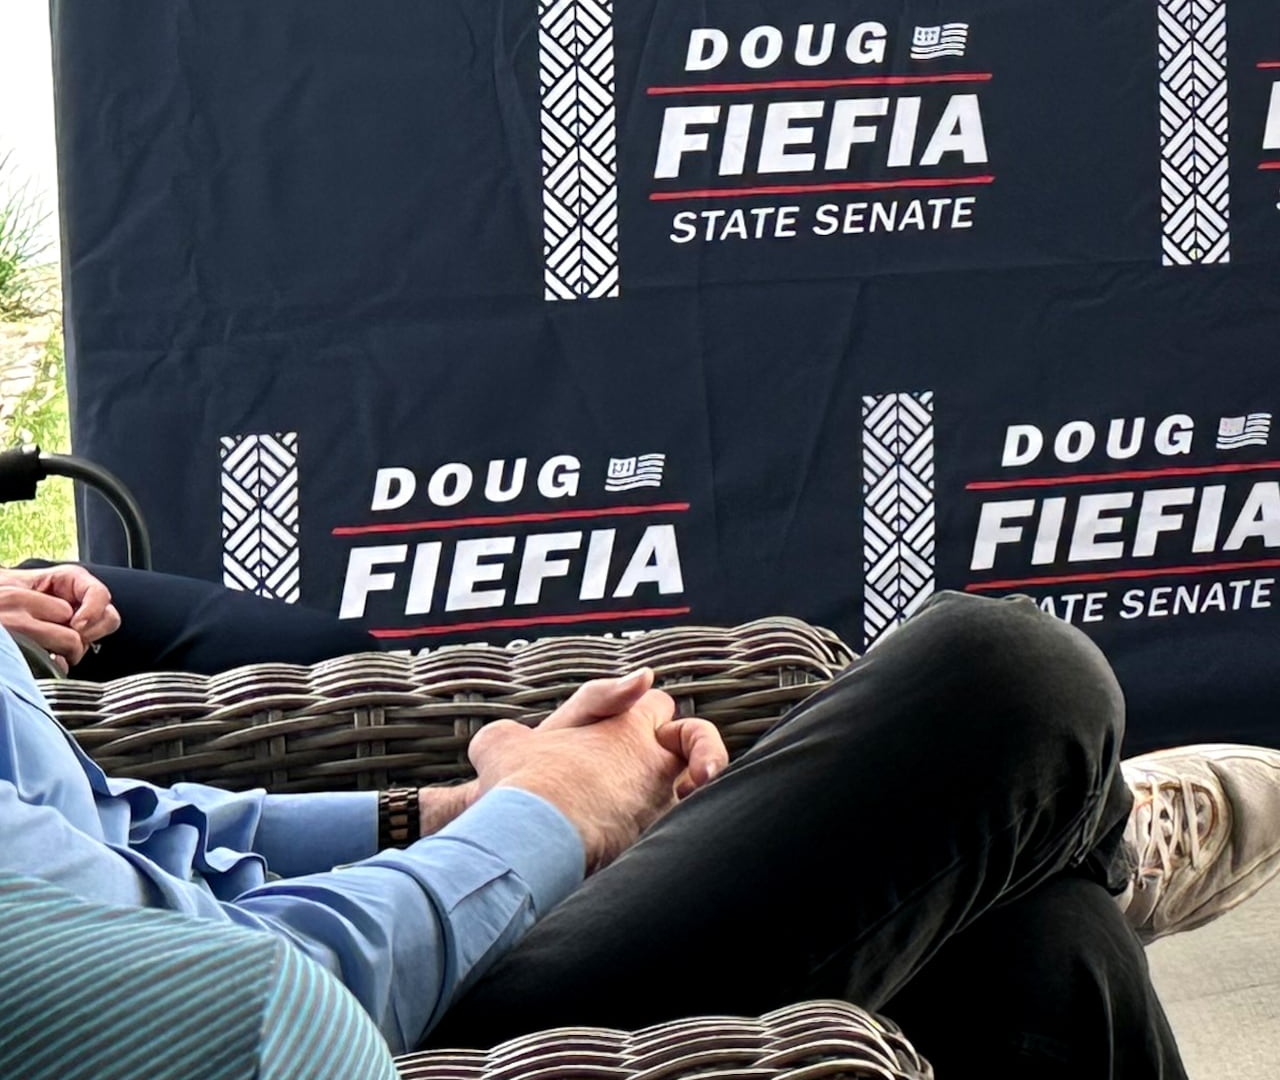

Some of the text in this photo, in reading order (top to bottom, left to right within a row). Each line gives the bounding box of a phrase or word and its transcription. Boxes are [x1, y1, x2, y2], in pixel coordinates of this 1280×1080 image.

[684, 21, 888, 71] DOUG
[653, 93, 988, 179] FIEFIA
[669, 196, 976, 244] STATE SENATE
[1001, 414, 1194, 467] DOUG
[370, 454, 581, 511] DOUG
[338, 524, 684, 620] FIEFIA
[1035, 578, 1275, 623] ATE SENATE
